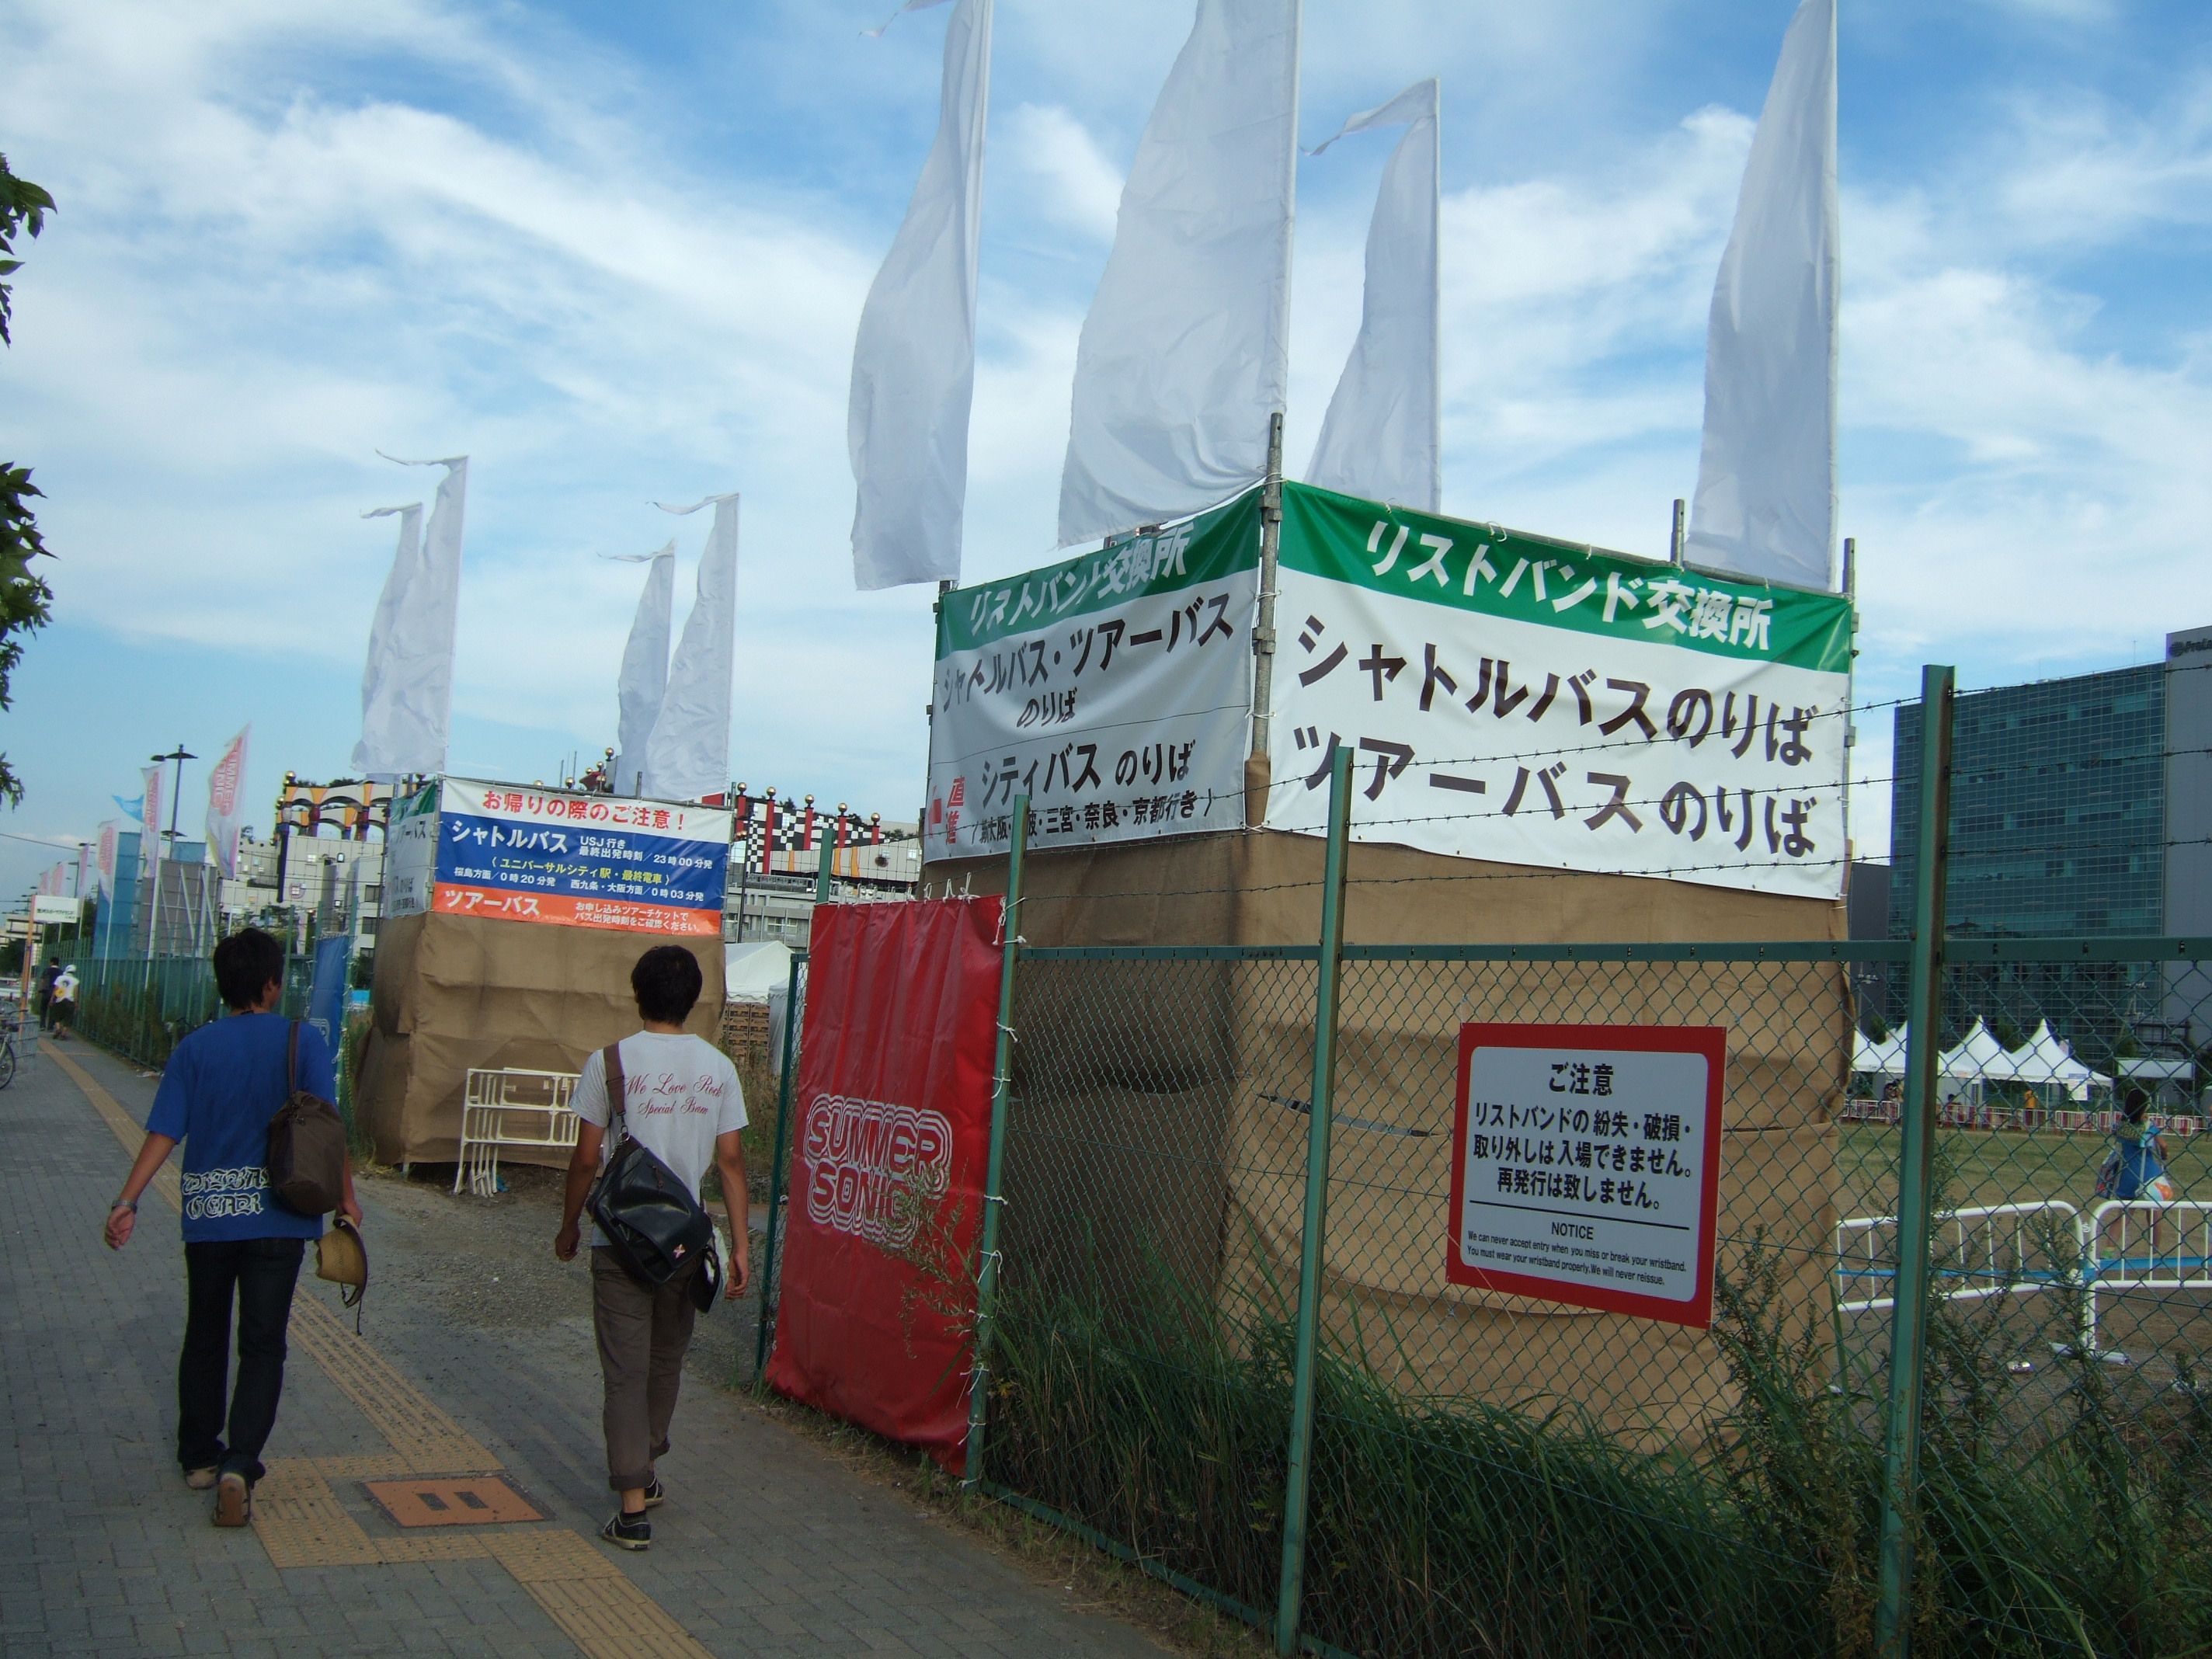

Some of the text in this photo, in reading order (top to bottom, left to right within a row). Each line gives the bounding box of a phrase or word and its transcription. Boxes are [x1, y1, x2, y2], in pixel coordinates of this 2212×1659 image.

[1367, 520, 1773, 652] リストバンド交換所
[943, 592, 1233, 712] シャトルバス・ツアーバス
[1017, 687, 1078, 729] のりば
[1298, 614, 1819, 767] シャトルバスのりば
[982, 739, 1196, 809] シティバス のりば
[1293, 725, 1819, 858] ツアーバスのりば
[483, 791, 683, 830] お帰りの際のご注意！
[452, 820, 568, 854] シャトルバス
[444, 890, 541, 916] ツアーバス
[625, 1073, 650, 1096] We
[652, 1073, 687, 1096] Love
[1549, 1062, 1614, 1096] ご注意
[638, 1098, 676, 1118] Special
[805, 1098, 951, 1186] SUMMER
[809, 1160, 917, 1240] SONIC
[1497, 1167, 1660, 1210] 再発行は致しません。
[1468, 1230, 1476, 1241] We
[1479, 1233, 1490, 1243] can
[1491, 1236, 1508, 1245] never
[1510, 1238, 1532, 1250] accept
[1532, 1241, 1549, 1253] entry
[1552, 1243, 1568, 1254] when
[1571, 1247, 1583, 1257] you
[1584, 1249, 1599, 1259] miss
[1602, 1251, 1609, 1260] or
[1610, 1250, 1629, 1264] break
[1632, 1256, 1647, 1267] your
[1551, 1222, 1594, 1240] NOTICE
[1467, 1245, 1479, 1256] You
[1480, 1248, 1494, 1258] must
[1497, 1250, 1511, 1261] wear
[1513, 1253, 1528, 1264] your
[1529, 1254, 1560, 1268] wristband
[1602, 1267, 1614, 1278] will
[1616, 1270, 1636, 1280] never
